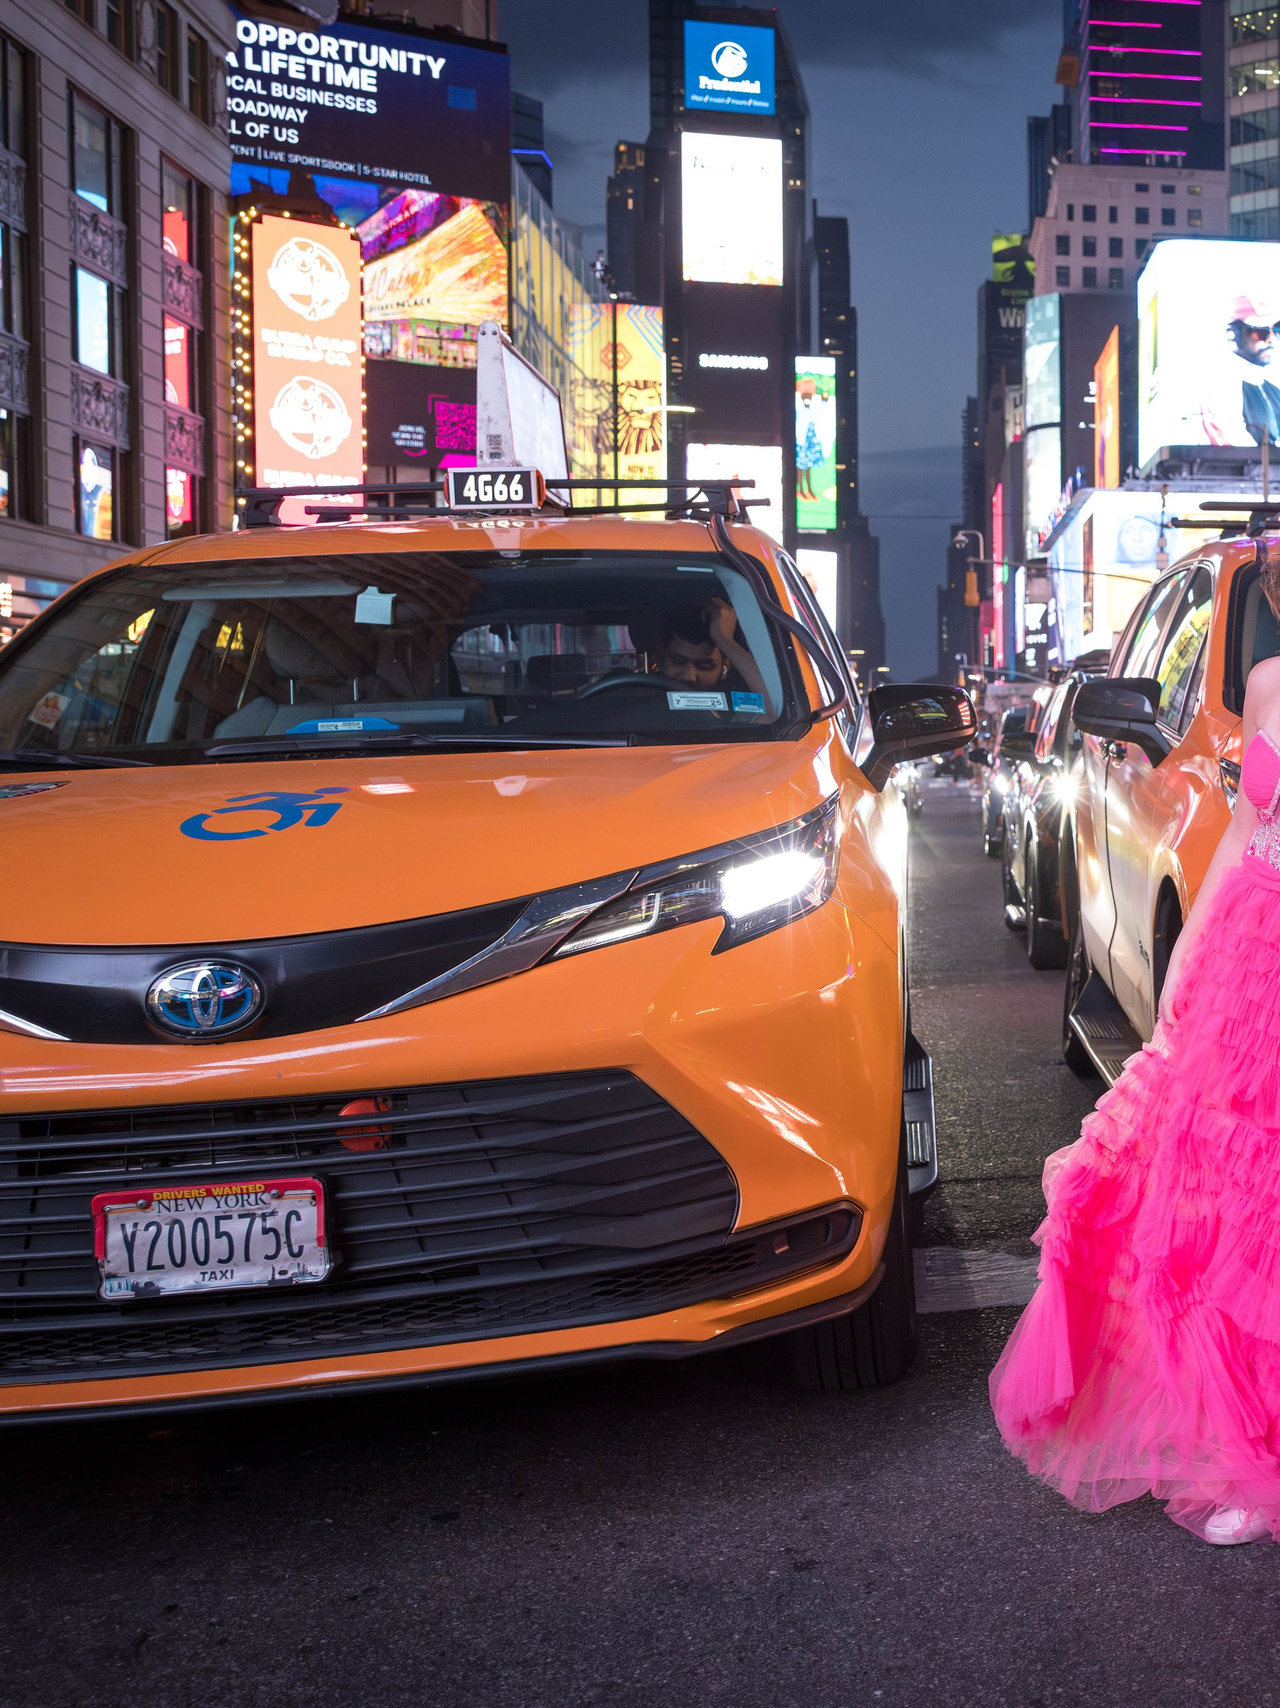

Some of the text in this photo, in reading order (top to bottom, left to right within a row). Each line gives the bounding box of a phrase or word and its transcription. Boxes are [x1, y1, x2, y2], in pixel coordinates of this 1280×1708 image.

[236, 20, 446, 79] OPPORTUNITY
[244, 47, 378, 93] LIFETIME
[271, 82, 378, 115] BUSINESSES
[228, 118, 300, 144] L OF US
[230, 143, 256, 157] ENT
[263, 149, 287, 163] LIVE
[287, 153, 357, 173] SPORTSBOOK
[400, 170, 432, 185] HOTEL
[463, 474, 524, 502] 4G66
[152, 1183, 265, 1201] DRIVERS WANTED
[157, 1191, 271, 1214] NEW YORK
[120, 1209, 305, 1273] Y200575C
[199, 1269, 234, 1283] TAXI
